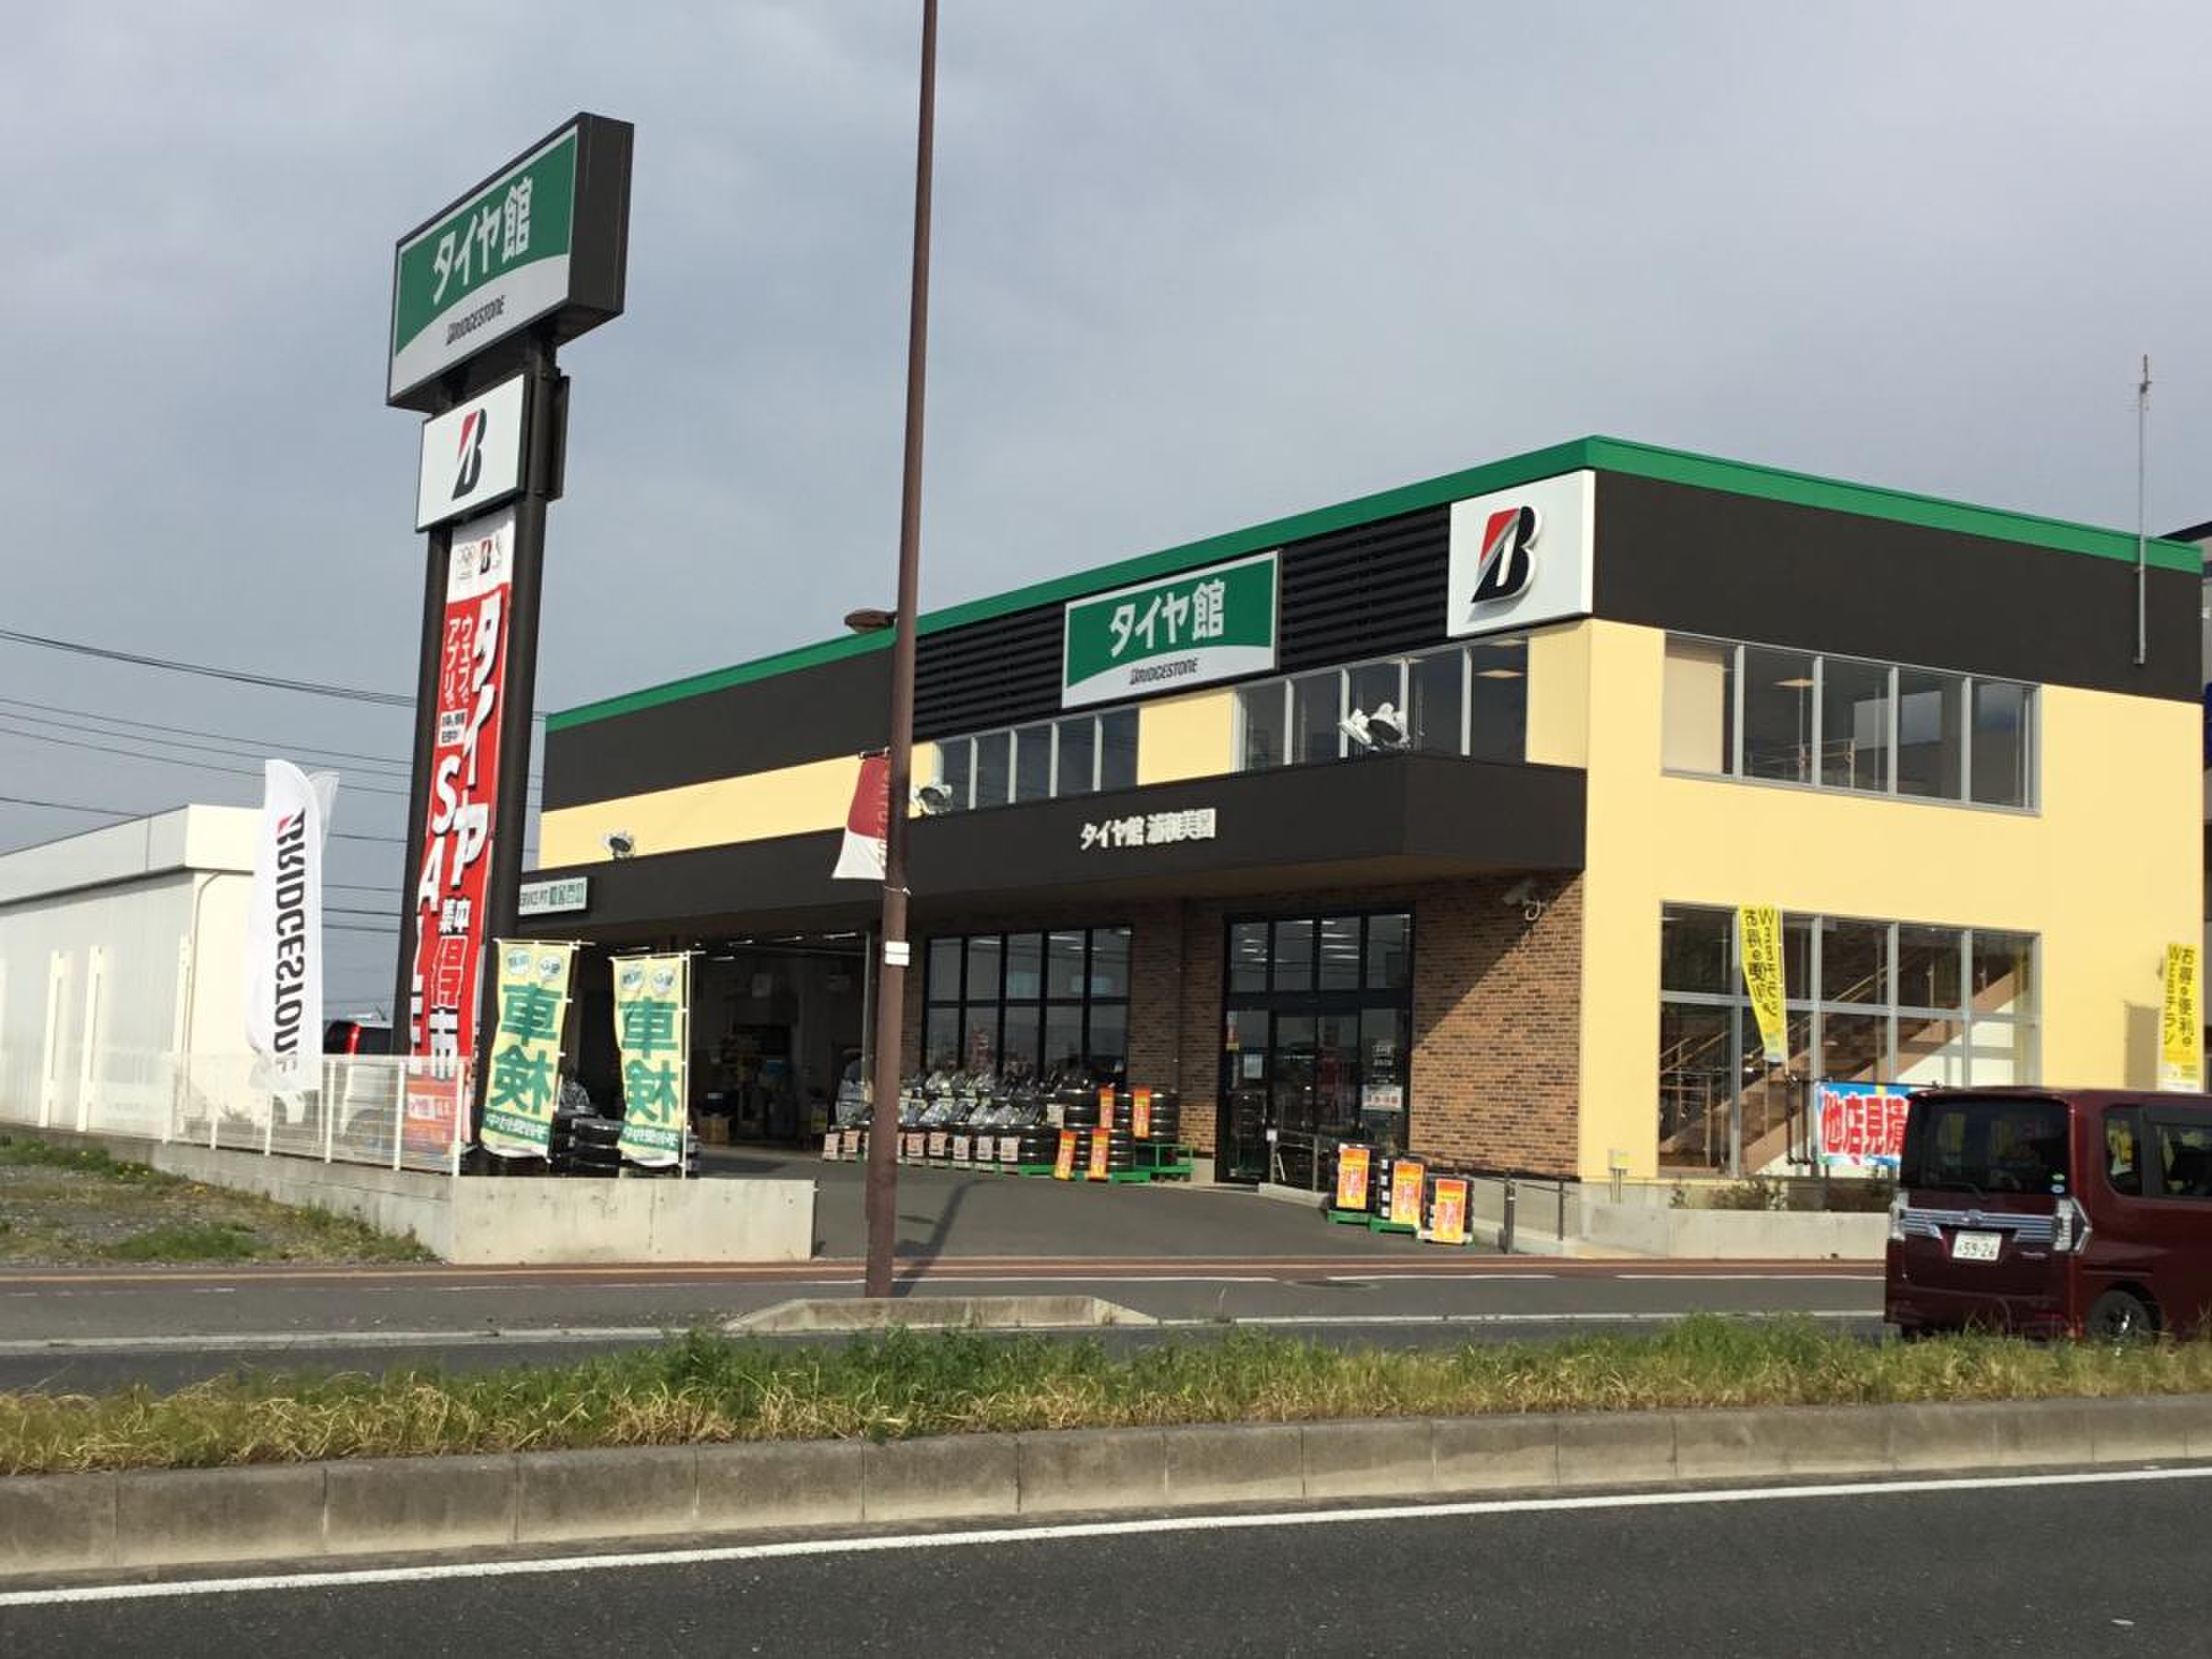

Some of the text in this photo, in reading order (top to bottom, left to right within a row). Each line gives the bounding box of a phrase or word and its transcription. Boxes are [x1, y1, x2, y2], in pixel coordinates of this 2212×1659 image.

[432, 176, 533, 305] タイヤ館
[1109, 578, 1225, 658] タイヤ館
[1080, 816, 1145, 850] タイヤ館
